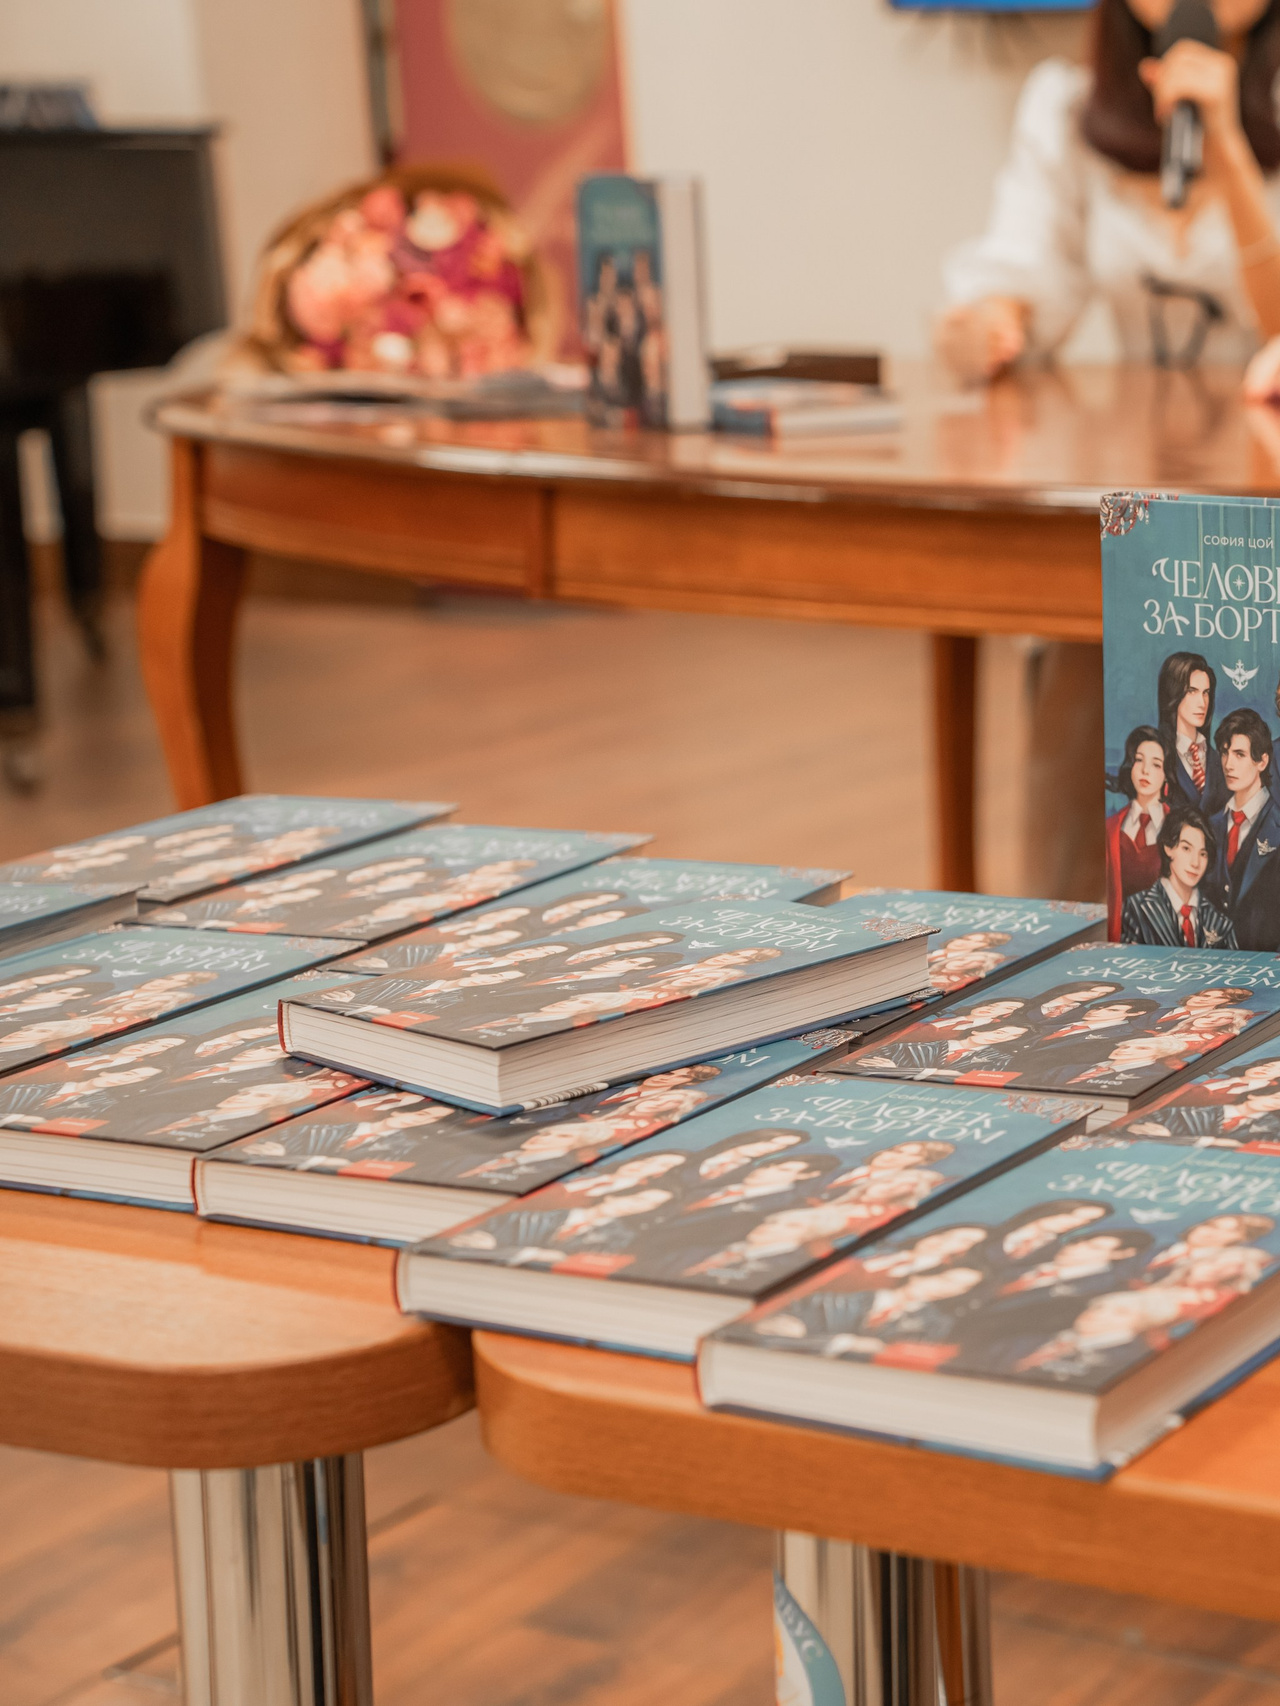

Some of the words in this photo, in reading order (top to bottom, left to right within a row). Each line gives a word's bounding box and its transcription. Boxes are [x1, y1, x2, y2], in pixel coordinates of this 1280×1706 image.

[1204, 535, 1244, 547] СОФИЯ
[1248, 537, 1274, 550] ЦОЙ
[1143, 599, 1190, 636] ЗА
